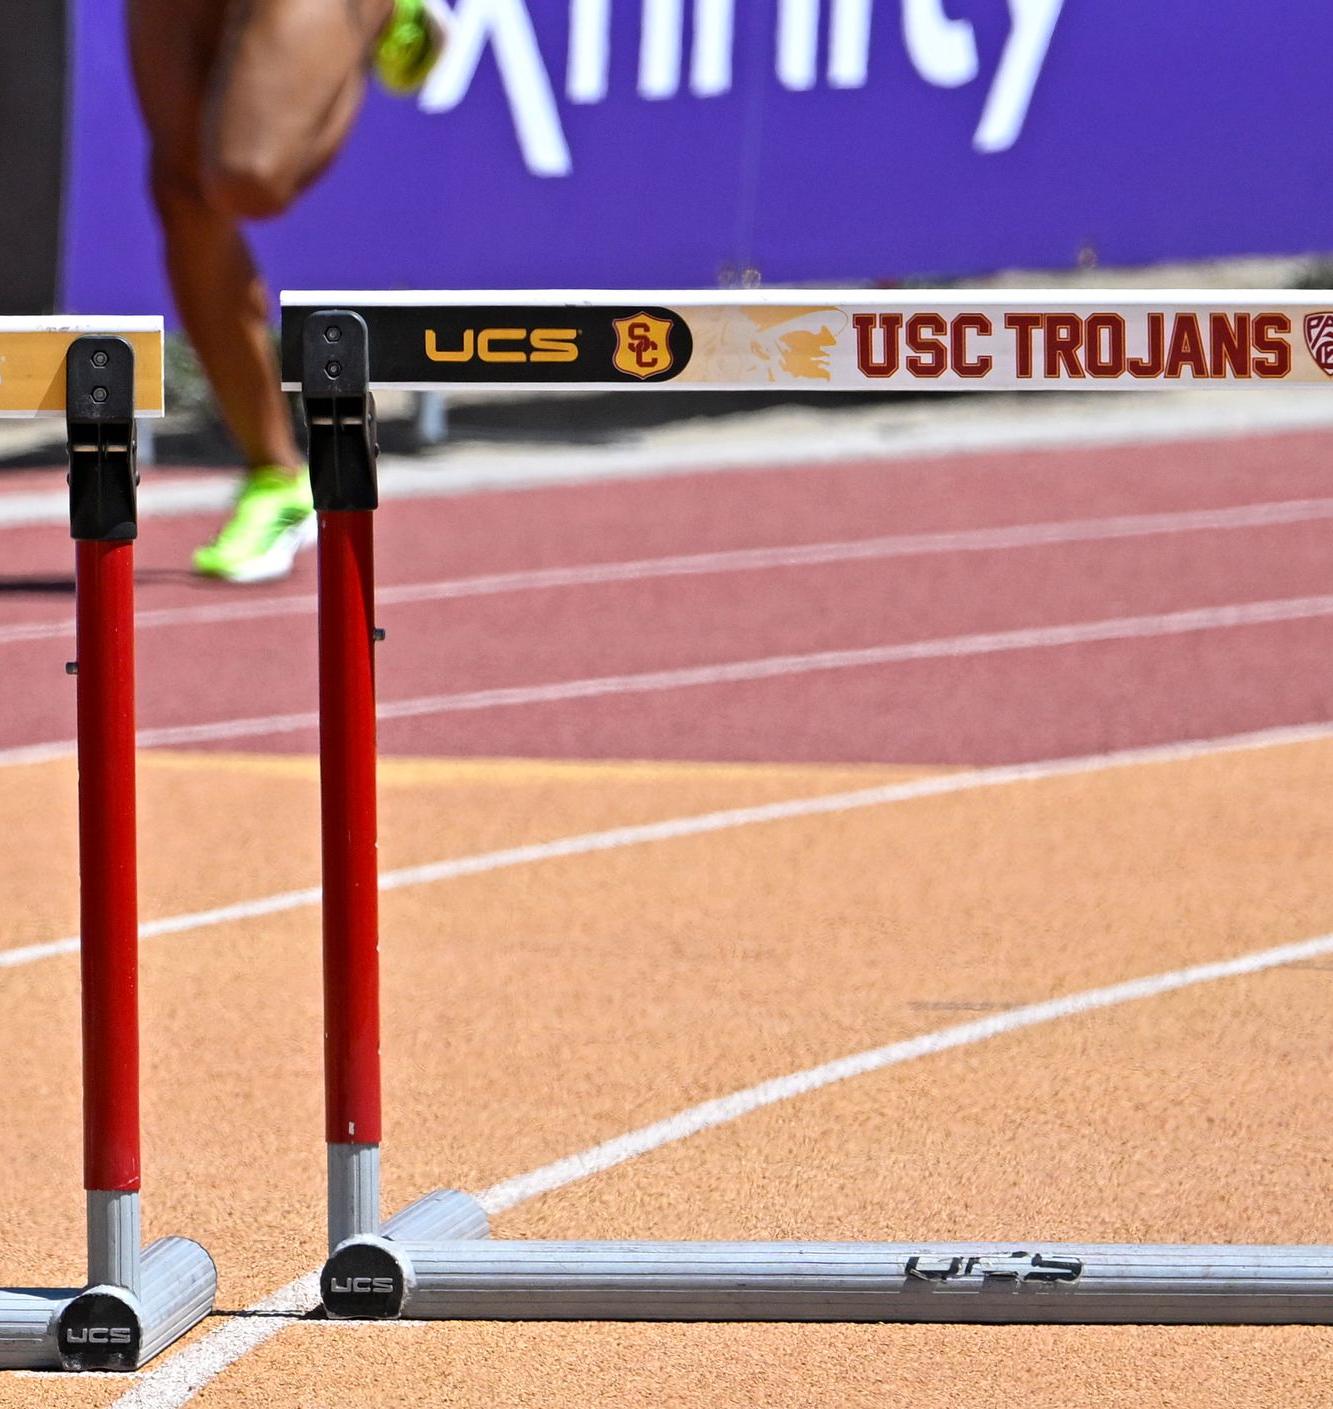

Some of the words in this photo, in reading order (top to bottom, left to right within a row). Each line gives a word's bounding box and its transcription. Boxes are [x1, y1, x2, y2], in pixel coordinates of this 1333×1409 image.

[424, 328, 579, 362] UCS
[852, 312, 994, 379] USC
[1004, 312, 1291, 379] TROJANS
[330, 1277, 394, 1294] UCS
[66, 1327, 131, 1344] UCS
